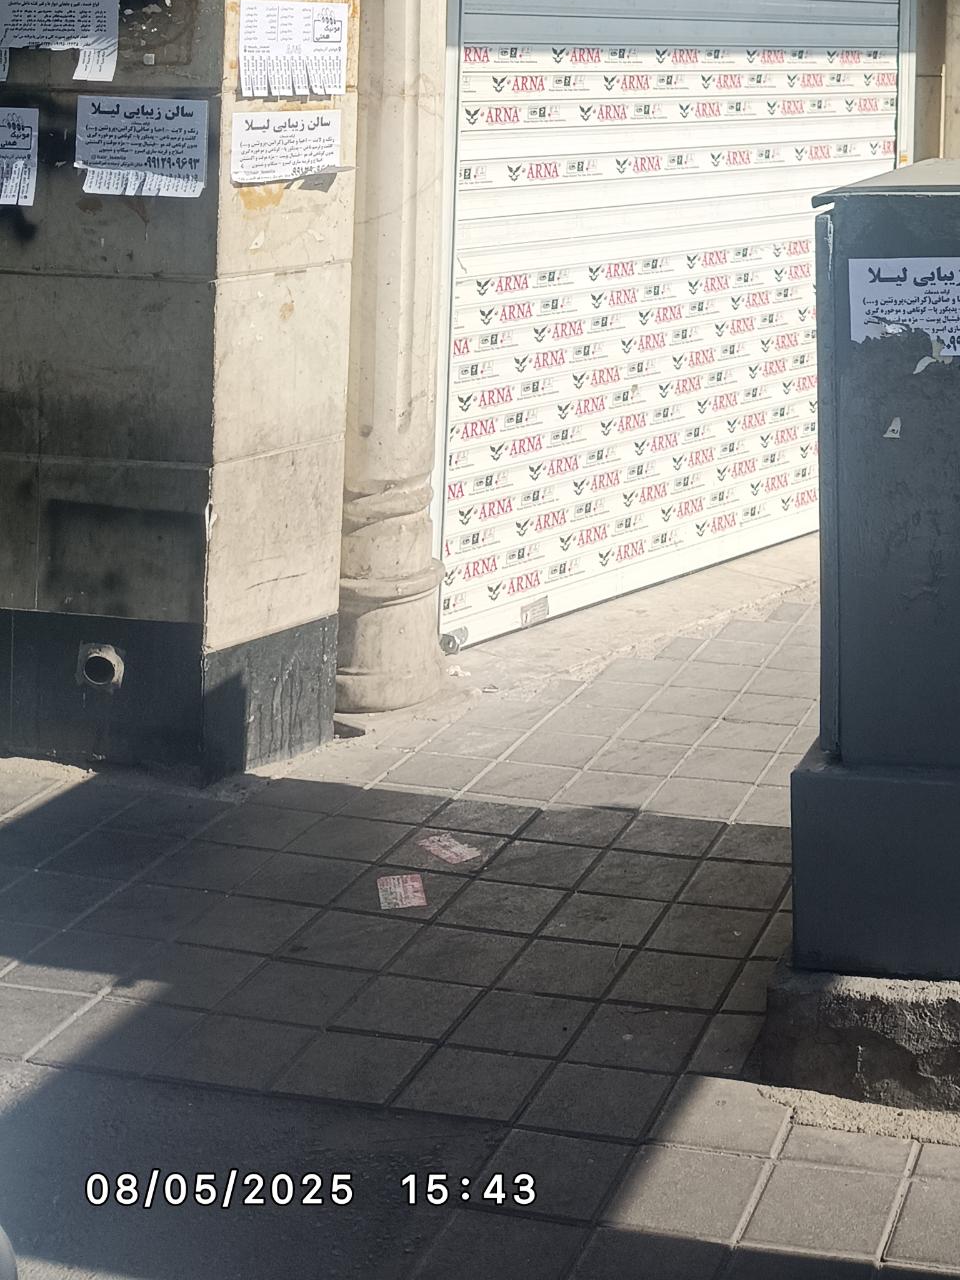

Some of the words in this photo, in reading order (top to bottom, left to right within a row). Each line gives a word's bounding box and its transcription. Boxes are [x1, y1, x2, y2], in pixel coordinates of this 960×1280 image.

[569, 48, 601, 64] ARNA
[672, 49, 698, 64] ARNA
[512, 76, 544, 93] ARNA
[617, 74, 650, 91] ARNA
[716, 74, 742, 90] ARNA
[123, 104, 162, 120] زیبایی
[164, 106, 194, 120] سالن
[486, 106, 519, 124] ARNA
[598, 105, 627, 121] ARNA
[695, 101, 720, 117] ARNA
[273, 119, 305, 133] زیبایی
[307, 116, 331, 131] سالن
[527, 161, 559, 180] ARNA
[633, 156, 660, 173] ARNA
[700, 250, 727, 267] ARNA
[607, 263, 633, 278] ARNA
[788, 262, 810, 281] ARNA
[496, 274, 528, 293] ARNA
[704, 276, 729, 293] ARNA
[608, 288, 637, 306] ARNA
[745, 292, 769, 308] ARNA
[499, 303, 532, 321] ARNA
[655, 306, 682, 324] ARNA
[907, 306, 927, 315] کوتاهی
[553, 322, 584, 340] ARNA
[730, 318, 753, 335] ARNA
[638, 333, 665, 351] ARNA
[534, 351, 565, 369] ARNA
[689, 349, 714, 367] ARNA
[763, 359, 786, 377] ARNA
[591, 368, 621, 387] ARNA
[675, 377, 700, 394] ARNA
[794, 375, 817, 393] ARNA
[479, 386, 512, 407] ARNA
[576, 396, 605, 415] ARNA
[712, 393, 737, 412] ARNA
[461, 418, 496, 440] ARNA
[618, 414, 646, 432] ARNA
[742, 413, 767, 430] ARNA
[510, 436, 542, 455] ARNA
[649, 433, 677, 452] ARNA
[548, 457, 579, 477] ARNA
[689, 449, 714, 467] ARNA
[729, 459, 756, 478] ARNA
[591, 470, 620, 492] ARNA
[762, 473, 788, 493] ARNA
[640, 484, 667, 502] ARNA
[793, 489, 816, 508] ARNA
[479, 497, 513, 519] ARNA
[673, 499, 703, 518] ARNA
[535, 512, 566, 532] ARNA
[709, 515, 736, 533] ARNA
[578, 526, 606, 546] ARNA
[616, 541, 644, 561] ARNA
[464, 557, 497, 580] ARNA
[507, 571, 540, 595] ARNA
